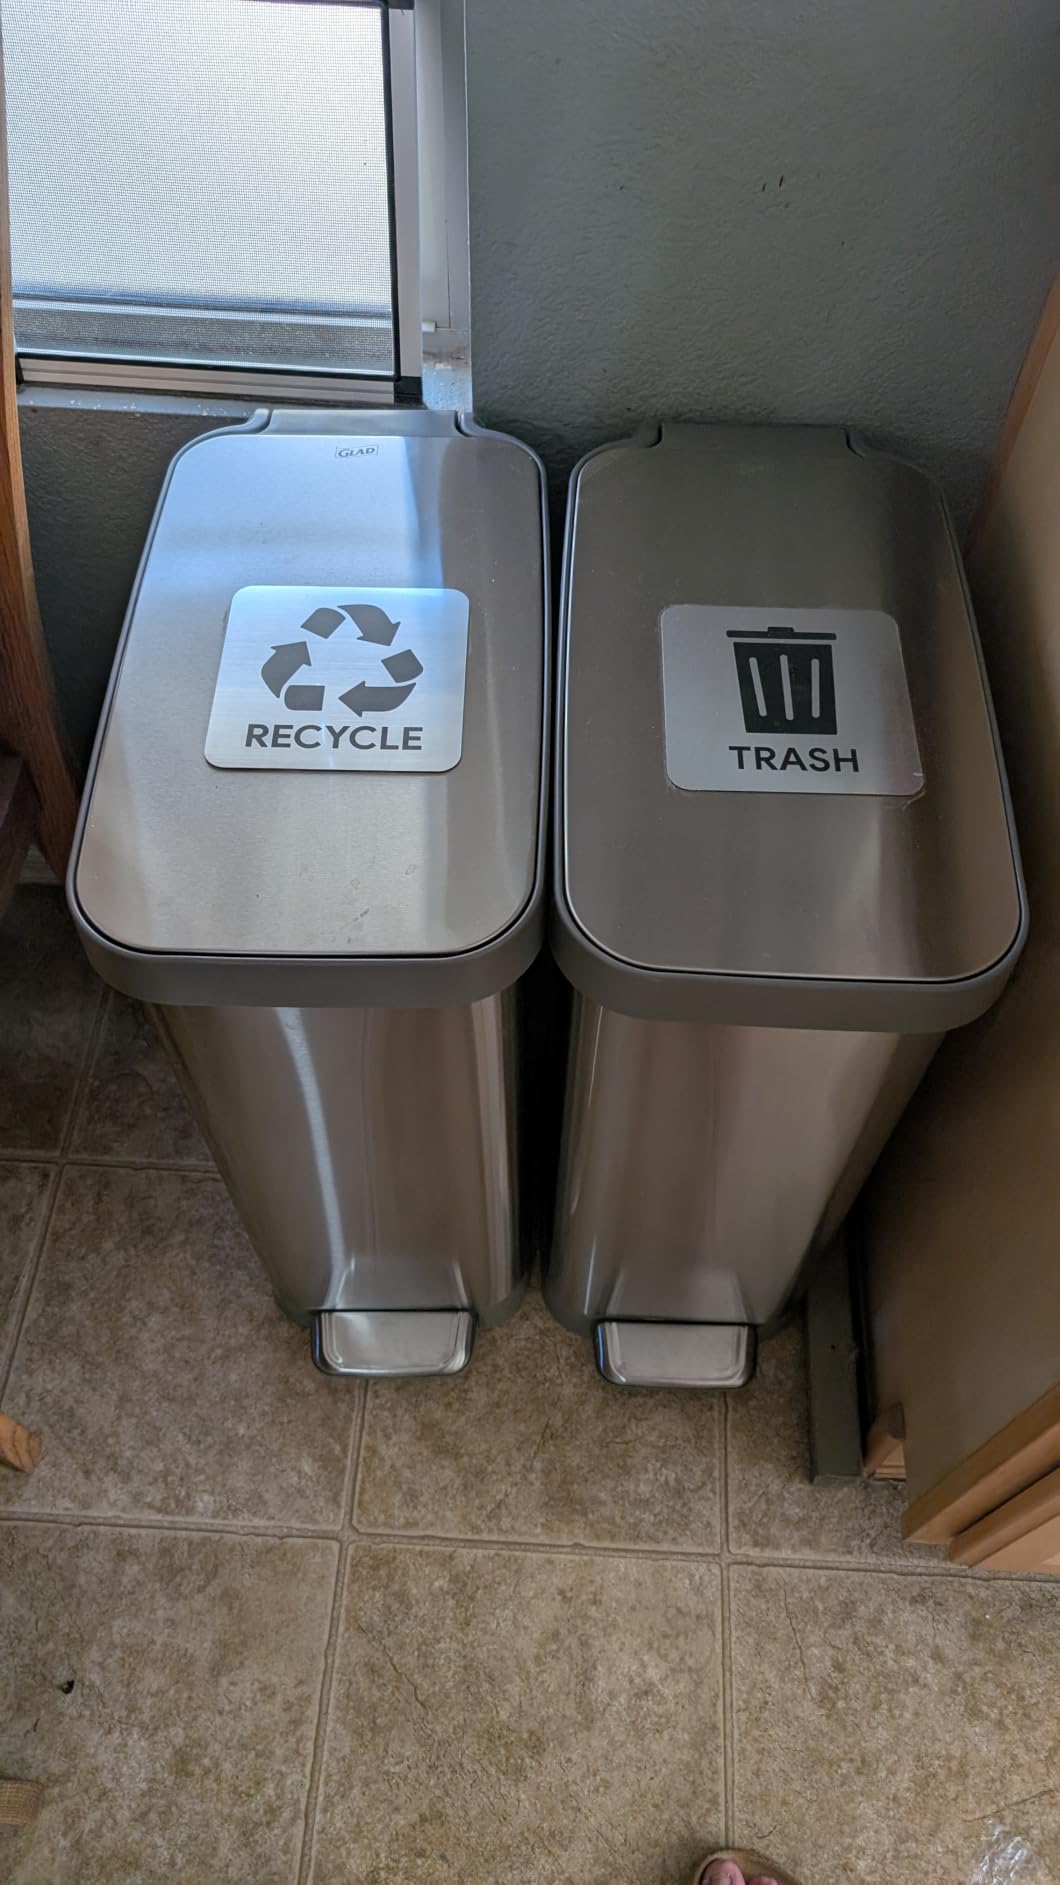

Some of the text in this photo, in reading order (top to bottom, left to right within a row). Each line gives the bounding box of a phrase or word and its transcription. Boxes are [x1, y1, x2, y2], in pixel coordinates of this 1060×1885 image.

[337, 447, 376, 458] GLAD
[245, 723, 424, 751] RECYCLE
[728, 745, 860, 773] TRASH
